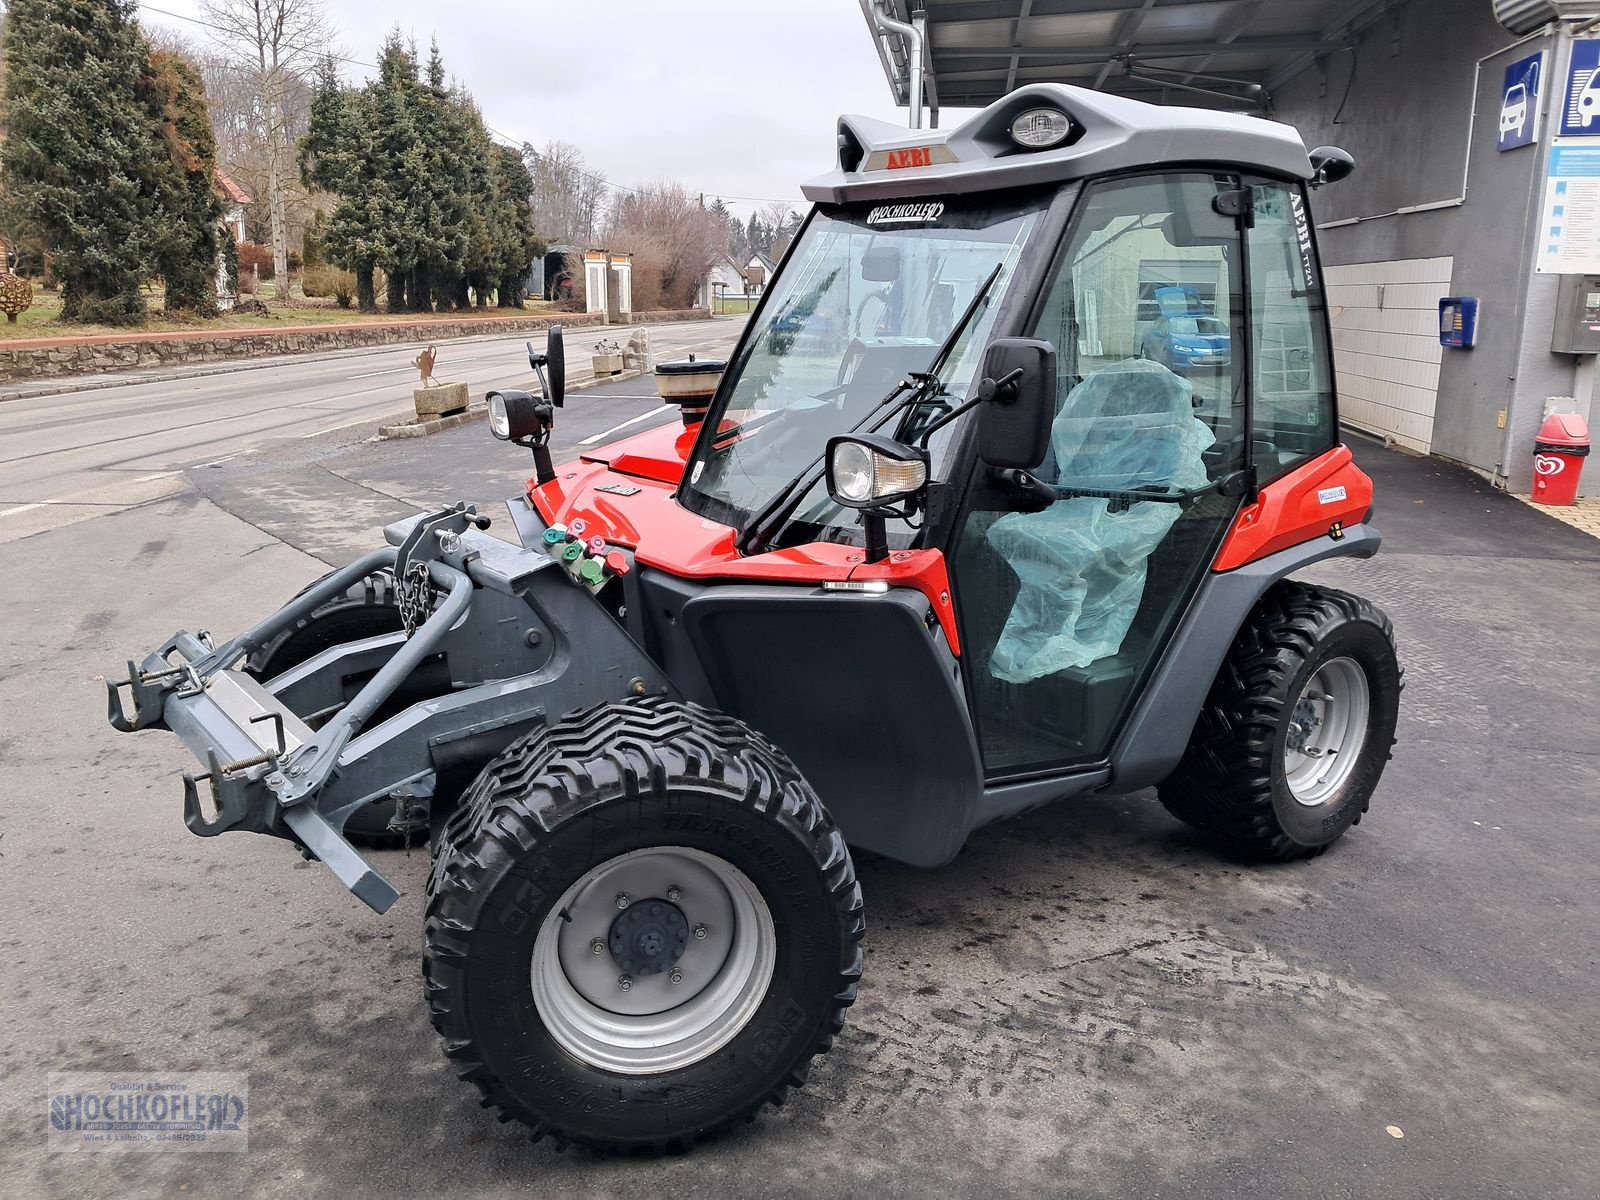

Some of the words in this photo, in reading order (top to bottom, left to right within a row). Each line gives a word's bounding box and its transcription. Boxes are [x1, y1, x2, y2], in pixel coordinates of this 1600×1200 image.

[887, 147, 932, 170] AEBI
[867, 203, 941, 224] HOCHKOFLER
[1289, 191, 1311, 253] AEBI
